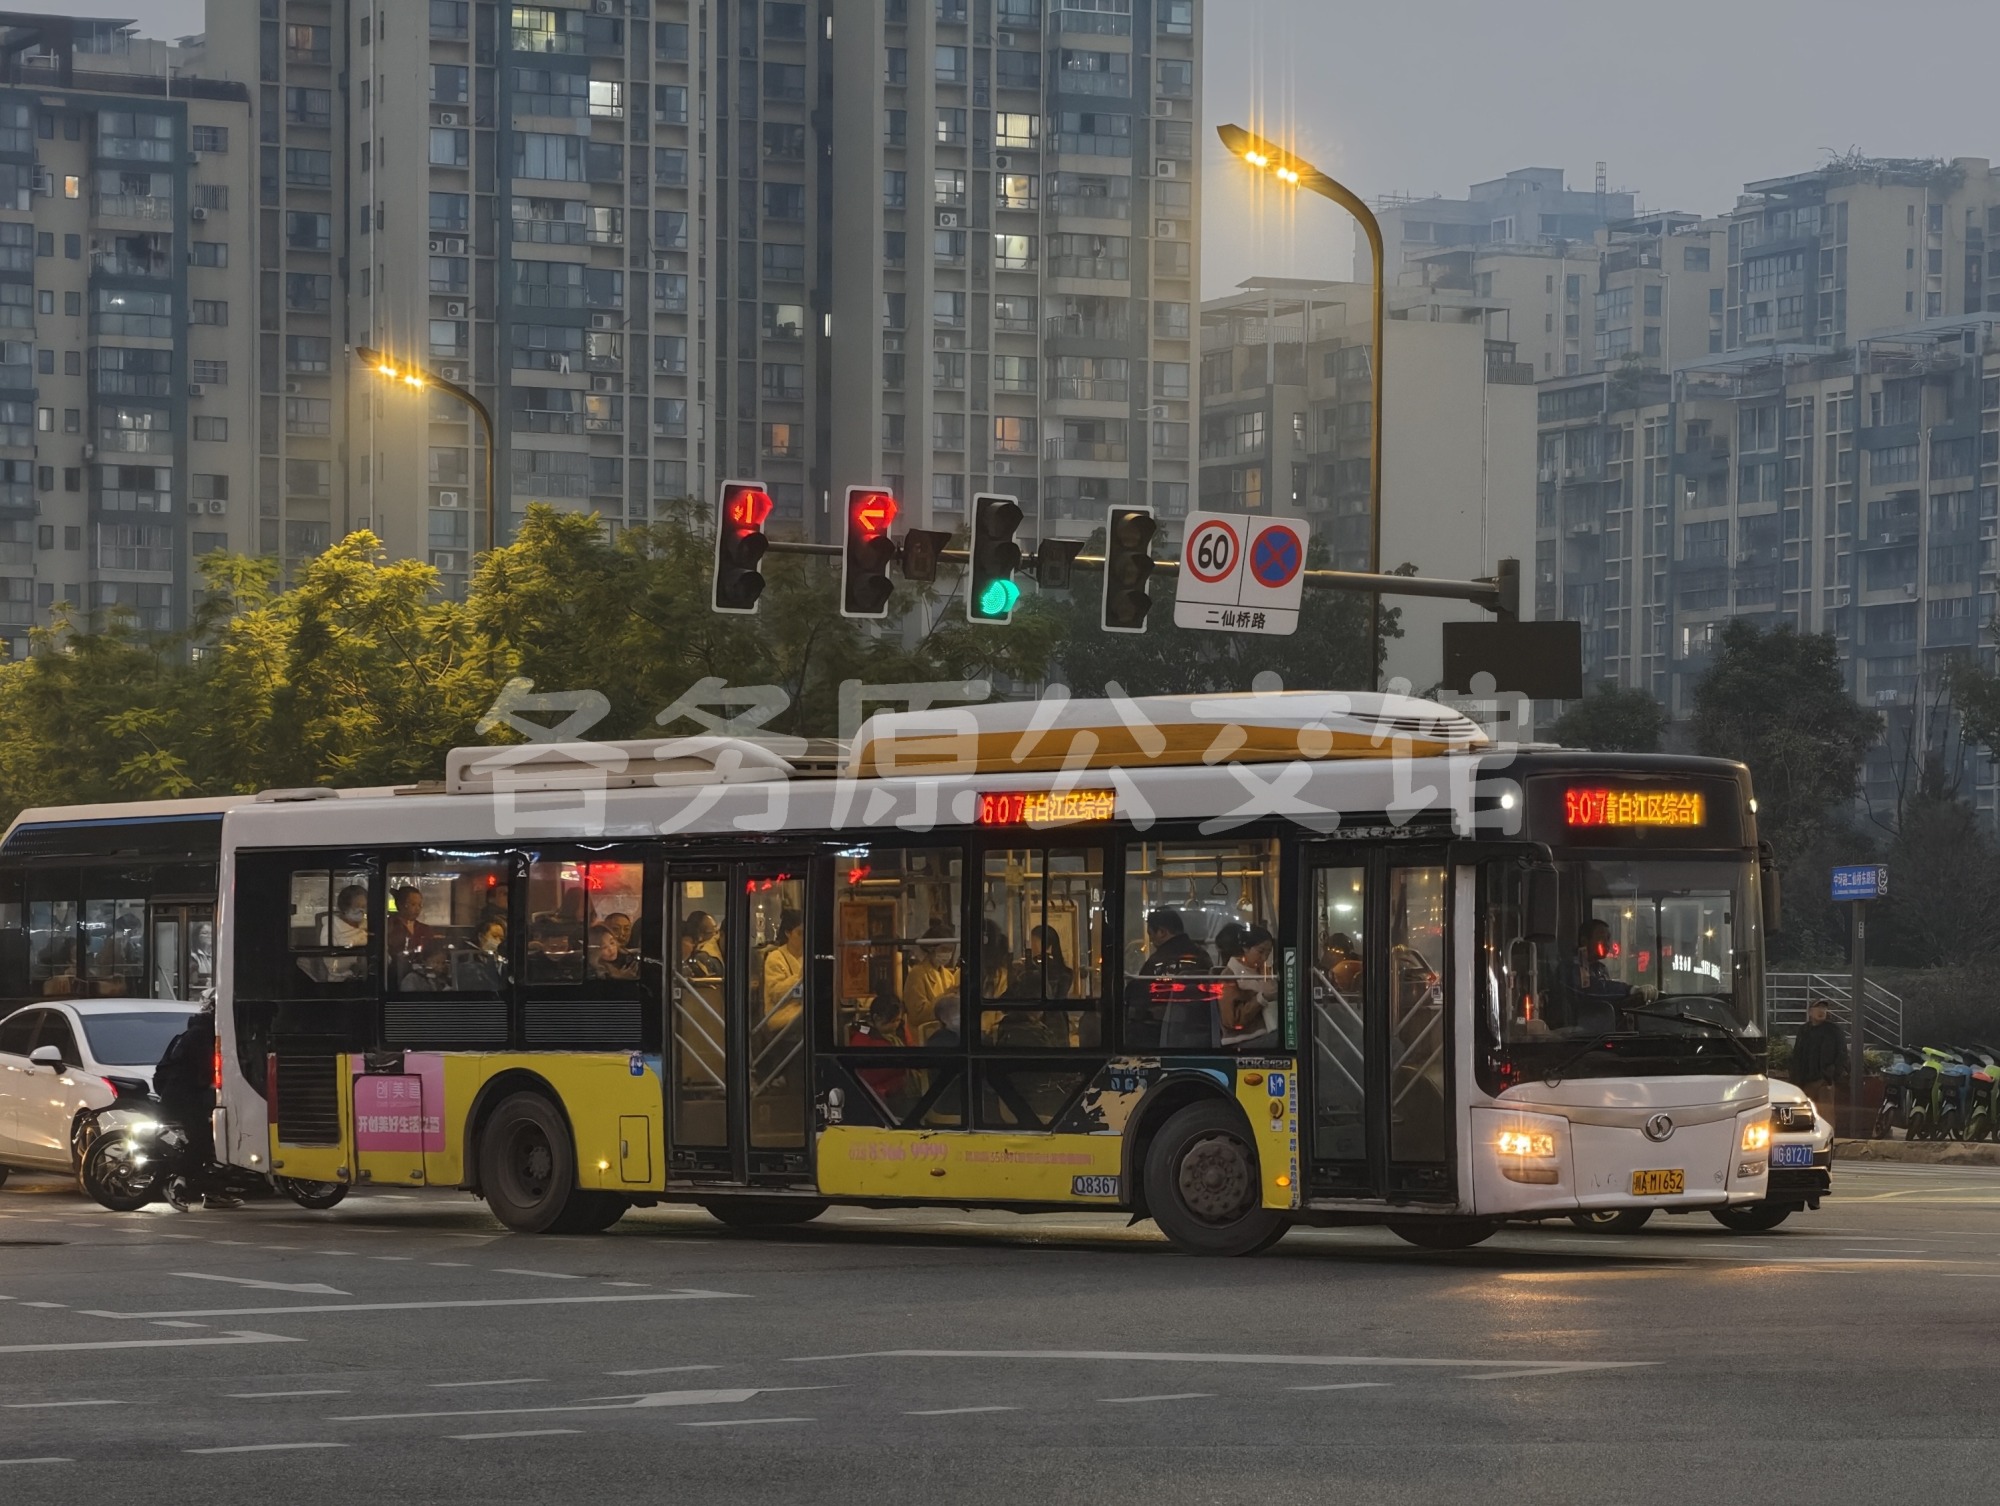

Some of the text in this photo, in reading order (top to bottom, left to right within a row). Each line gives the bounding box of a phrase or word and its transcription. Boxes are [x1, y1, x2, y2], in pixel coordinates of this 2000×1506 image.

[1198, 533, 1229, 570] 60
[1205, 610, 1266, 630] 二仙桥路
[983, 791, 1113, 823] 607 青白江区综合
[1075, 1177, 1118, 1195] Q8367
